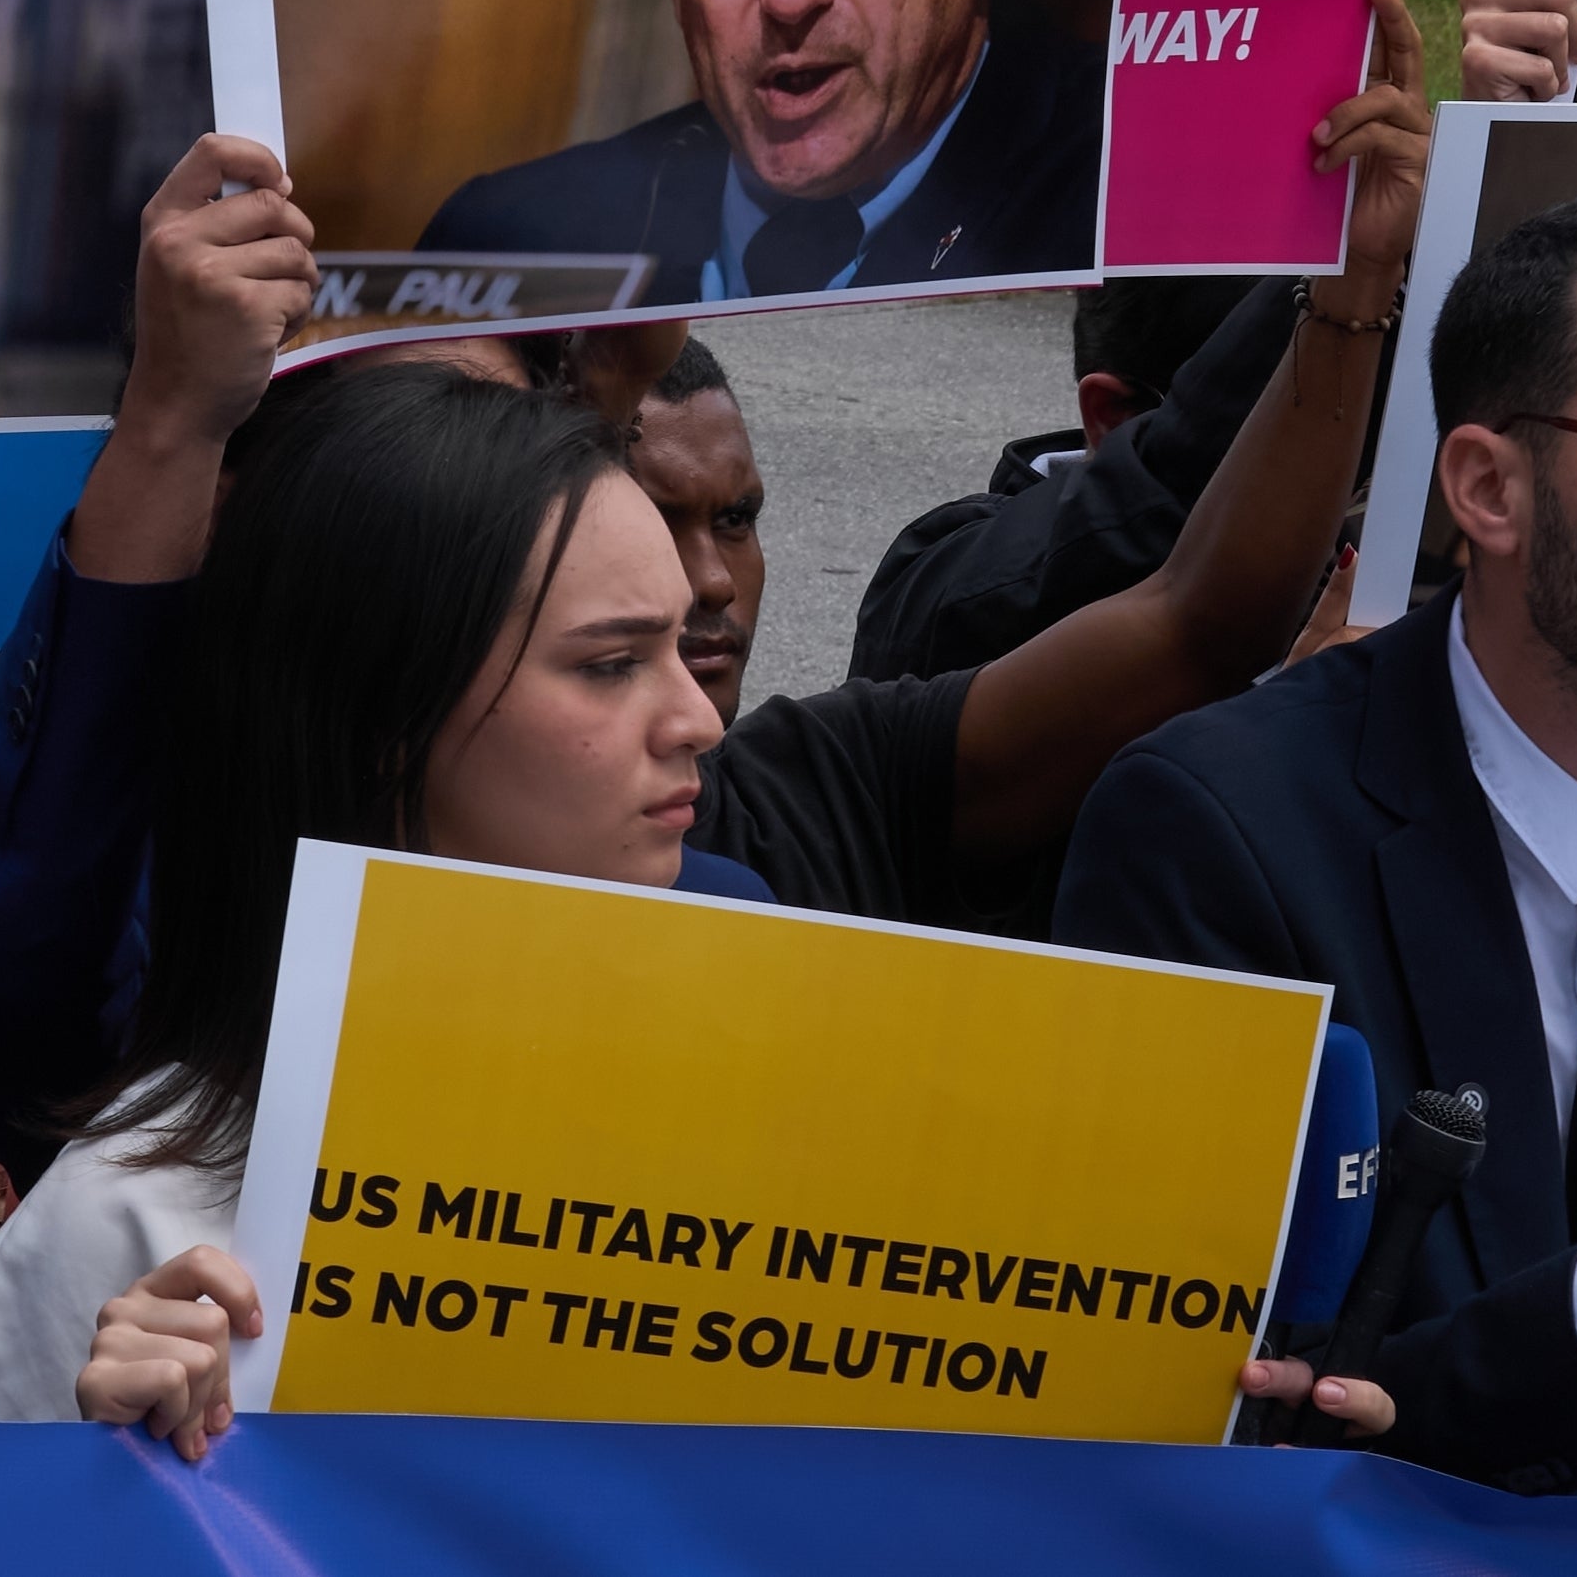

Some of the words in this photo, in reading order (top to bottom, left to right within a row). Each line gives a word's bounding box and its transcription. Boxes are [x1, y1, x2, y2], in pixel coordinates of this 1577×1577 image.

[386, 270, 523, 319] PAUL
[1337, 1143, 1380, 1199] EF
[309, 1167, 401, 1229] US
[417, 1181, 753, 1271] MILITARY
[767, 1221, 1267, 1336] INTERVENTION
[290, 1261, 355, 1318] IS
[371, 1271, 529, 1338] NOT
[542, 1291, 680, 1356] THE
[690, 1309, 1048, 1400] SOLUTION
